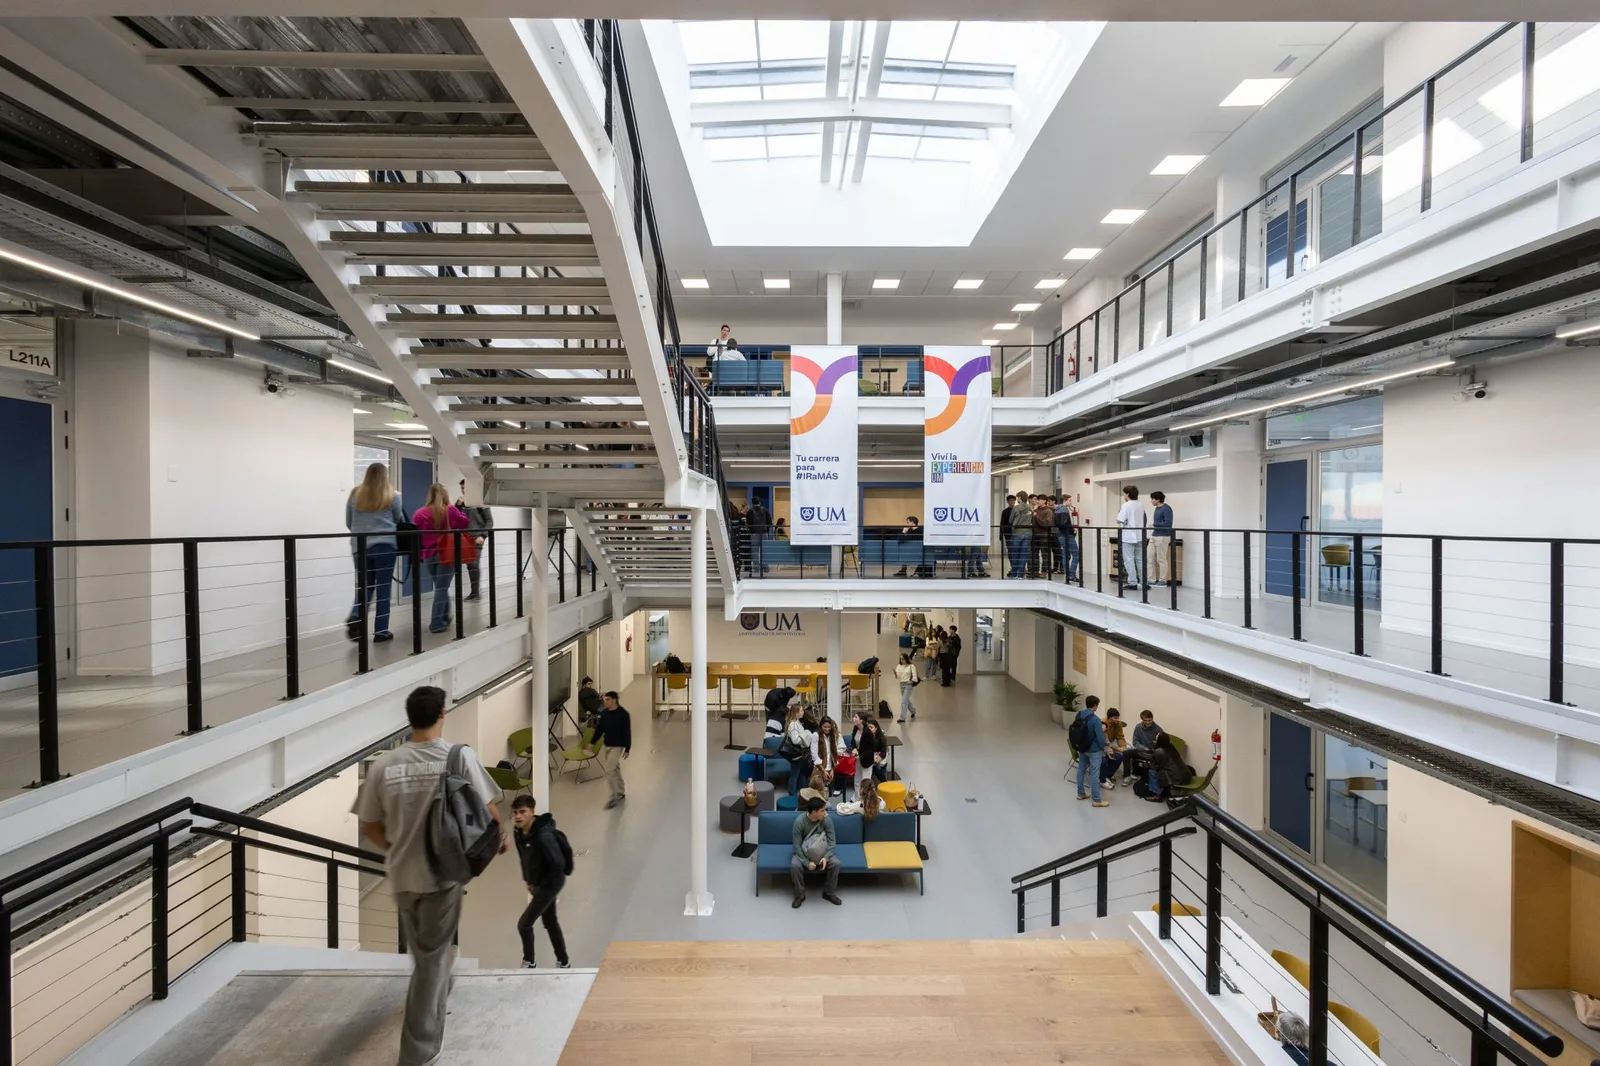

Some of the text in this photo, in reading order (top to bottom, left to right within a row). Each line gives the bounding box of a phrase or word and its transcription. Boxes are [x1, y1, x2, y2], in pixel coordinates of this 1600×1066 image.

[9, 349, 51, 369] L211A
[796, 454, 807, 462] Tu
[931, 452, 958, 461] Viví la
[796, 464, 816, 473] para
[931, 461, 985, 474] EXPERIENCIA
[796, 470, 839, 480] #IRaMÁS
[816, 507, 847, 522] UM
[950, 507, 980, 522] UM
[762, 612, 803, 631] UM
